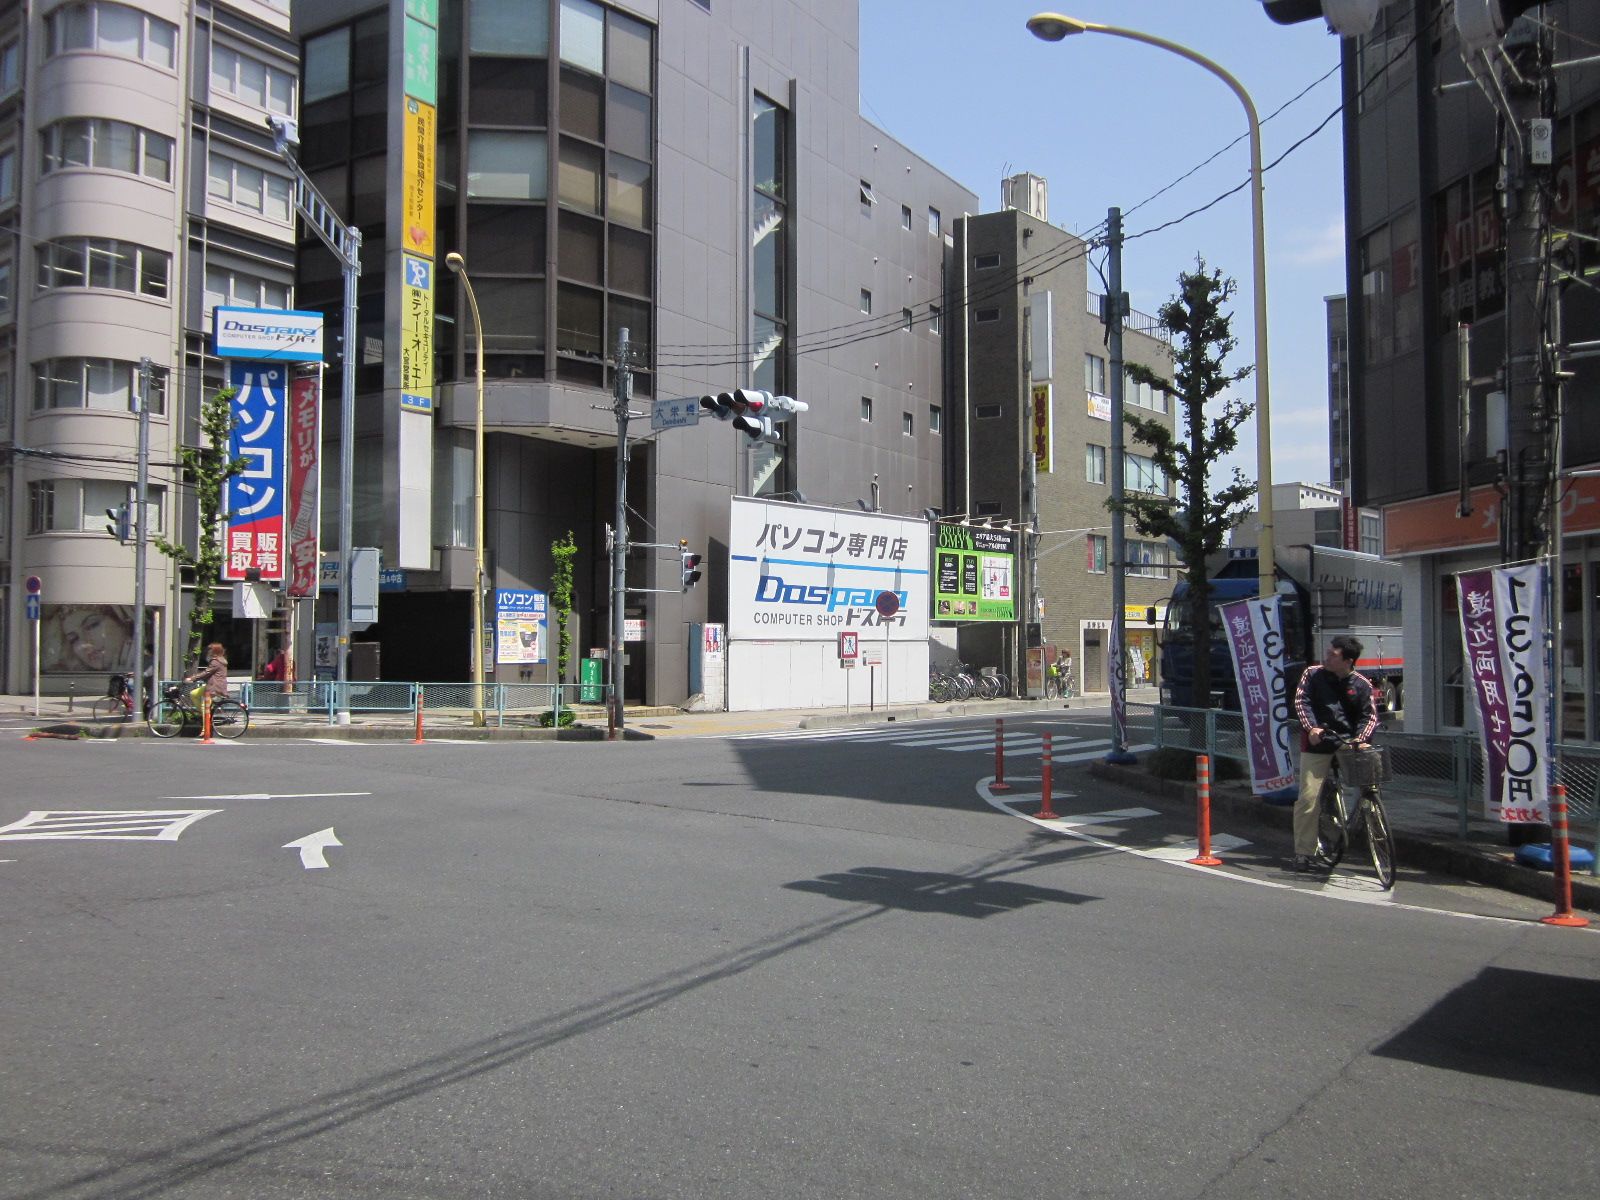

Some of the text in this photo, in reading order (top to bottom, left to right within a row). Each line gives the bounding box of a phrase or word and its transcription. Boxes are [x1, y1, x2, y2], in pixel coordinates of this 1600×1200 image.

[224, 321, 317, 337] Dospara
[297, 386, 316, 469] メモリが
[655, 403, 695, 419] 大栄橋
[237, 371, 278, 516] パソコン
[231, 531, 252, 571] 買取
[257, 532, 278, 571] 販売
[755, 523, 908, 561] パソコン専門店
[498, 592, 533, 606] パソコン
[754, 612, 813, 626] COMPUTER
[816, 614, 844, 626] SHOP
